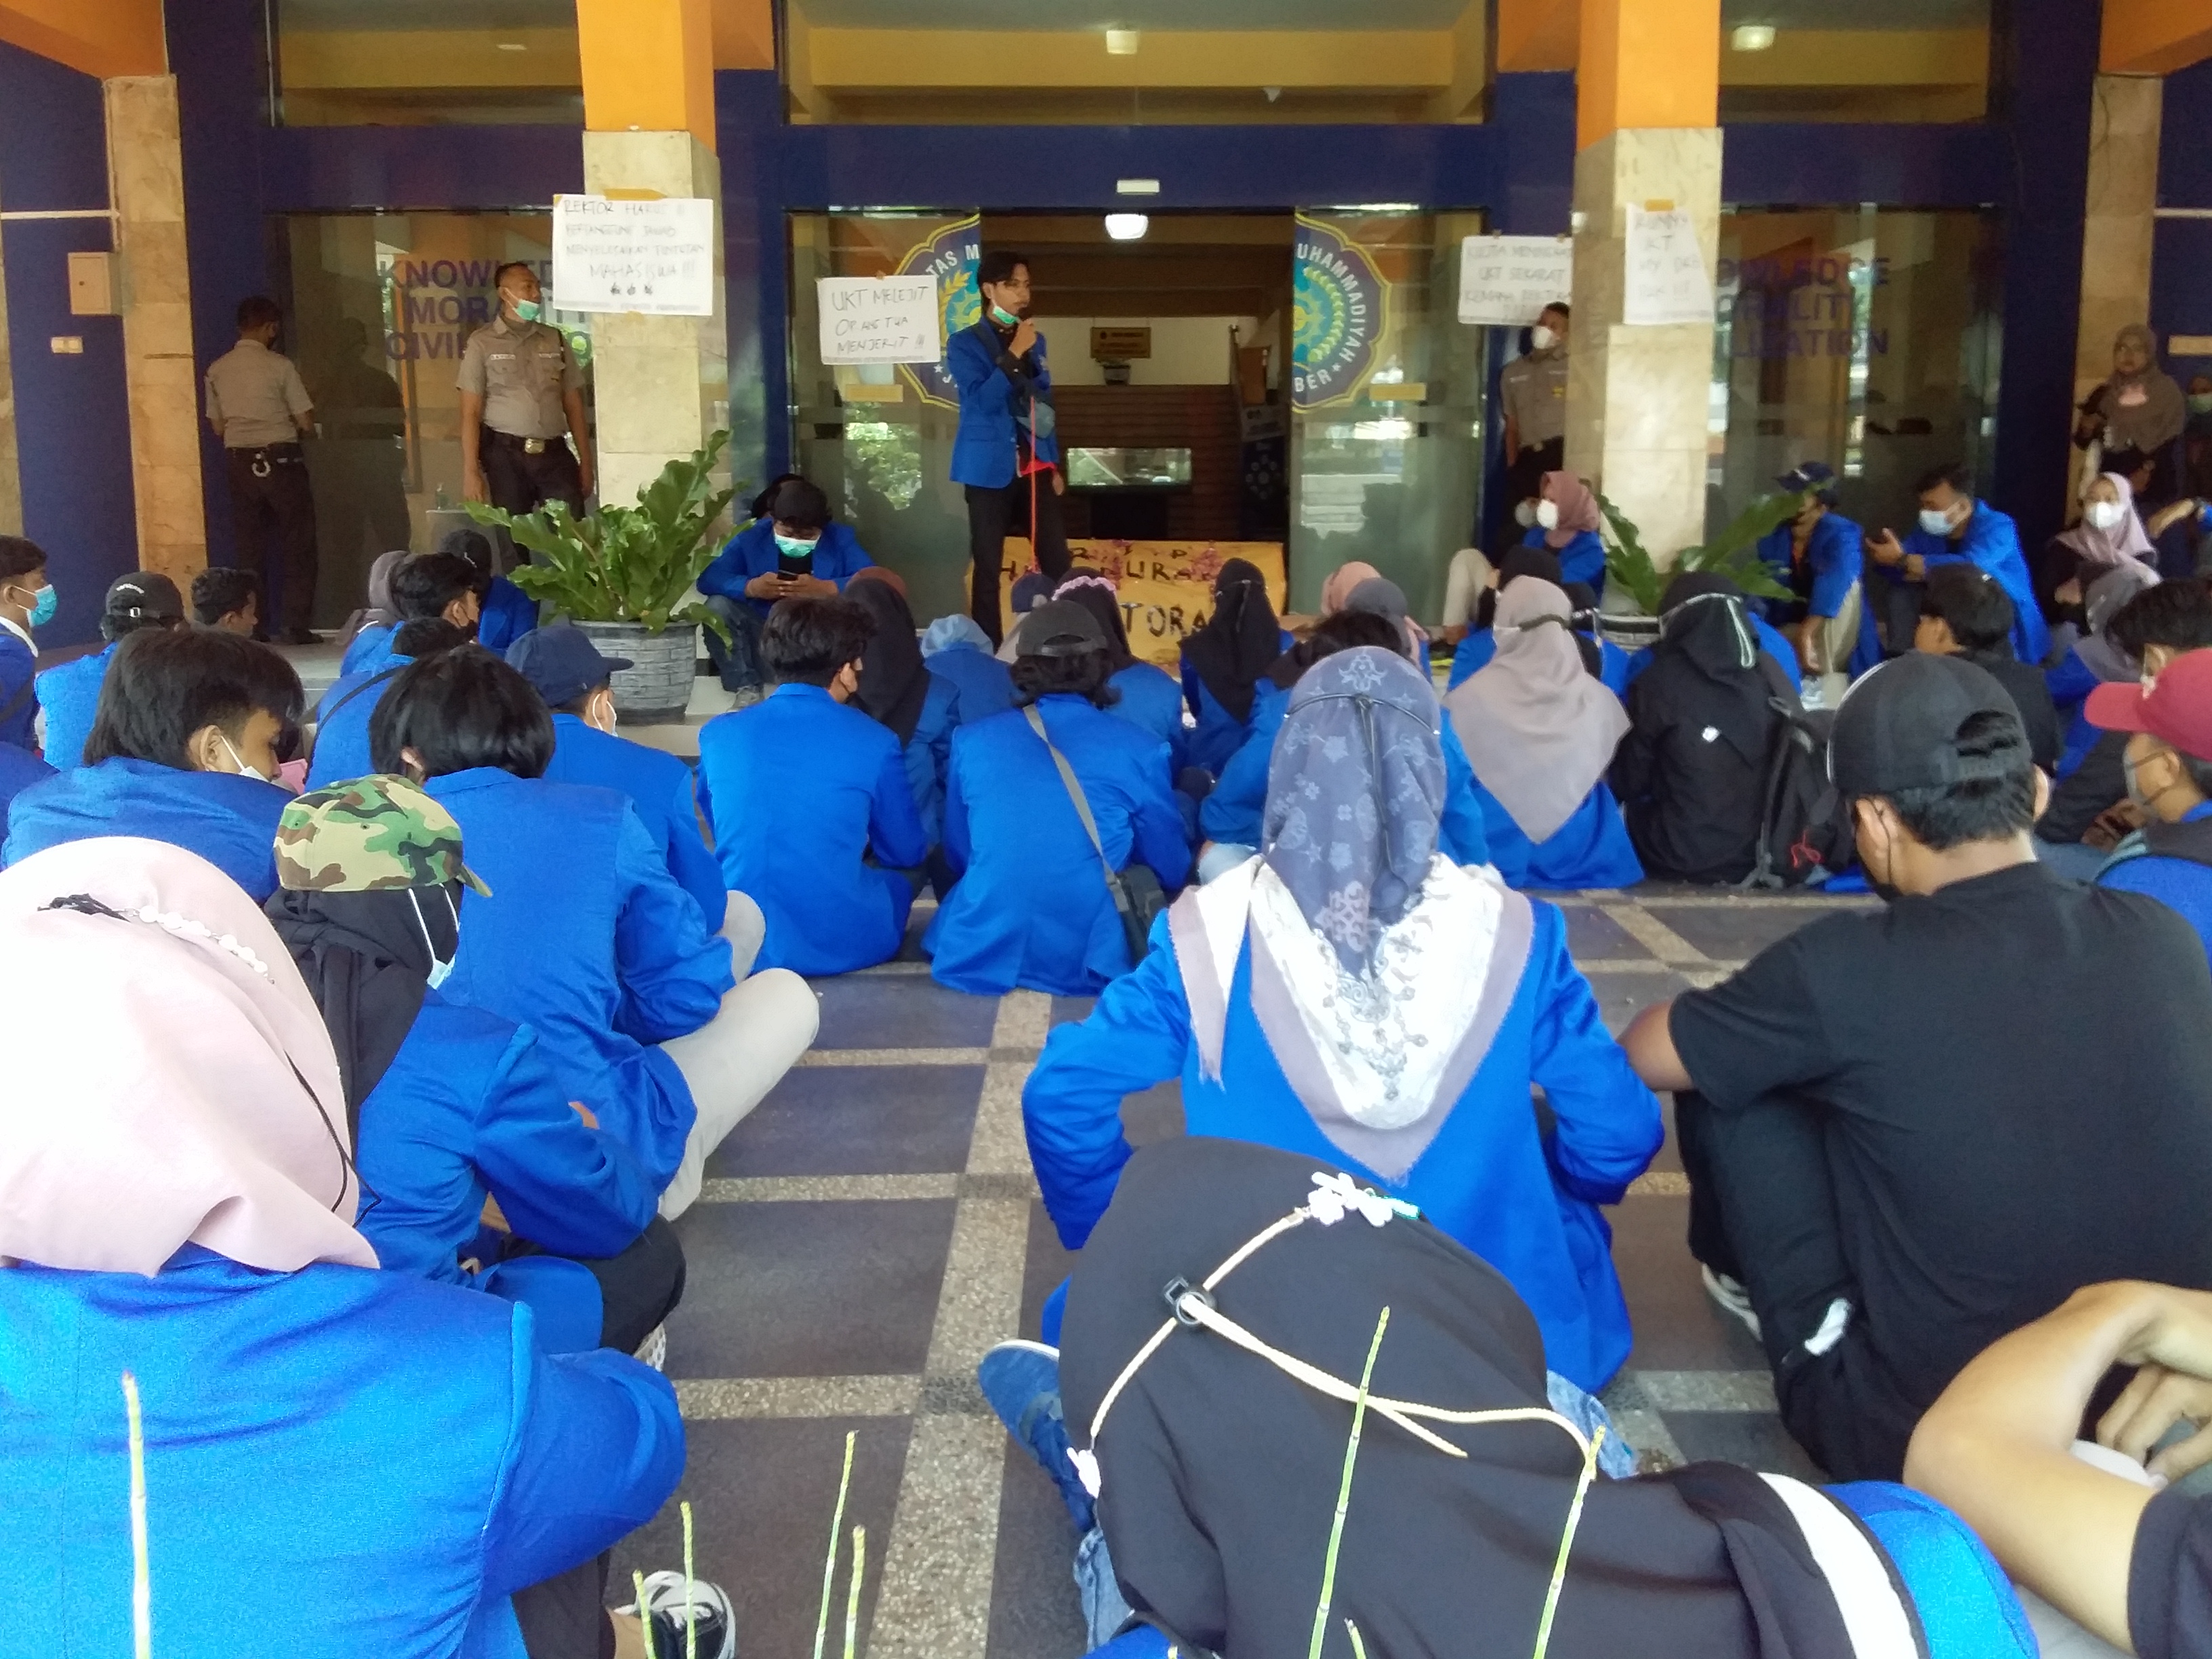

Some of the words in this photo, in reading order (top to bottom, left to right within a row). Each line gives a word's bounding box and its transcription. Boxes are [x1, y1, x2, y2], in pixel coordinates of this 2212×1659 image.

[565, 199, 614, 215] REKTOR
[832, 289, 868, 311] UKT
[873, 286, 929, 304] MELEJIT
[884, 316, 908, 329] TUA
[837, 336, 909, 354] MENJERIT
